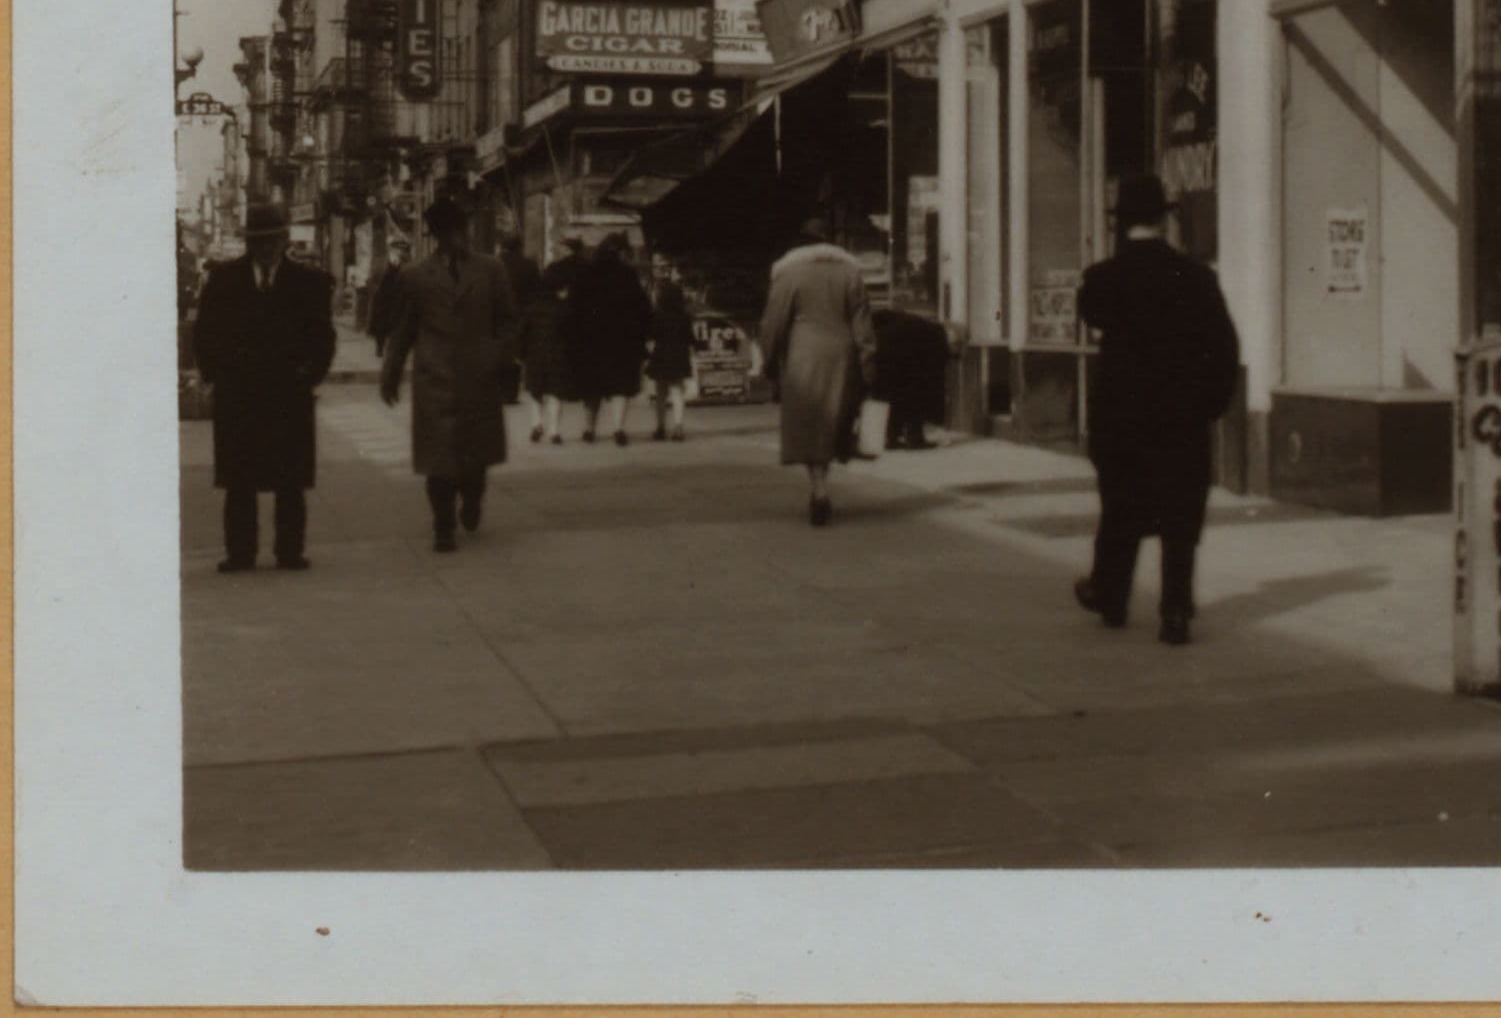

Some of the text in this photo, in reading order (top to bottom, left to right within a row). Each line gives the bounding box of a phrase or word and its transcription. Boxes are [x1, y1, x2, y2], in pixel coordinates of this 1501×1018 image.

[537, 0, 620, 36] GARCIA
[625, 5, 709, 42] GRANDE
[564, 34, 686, 55] CIGAR
